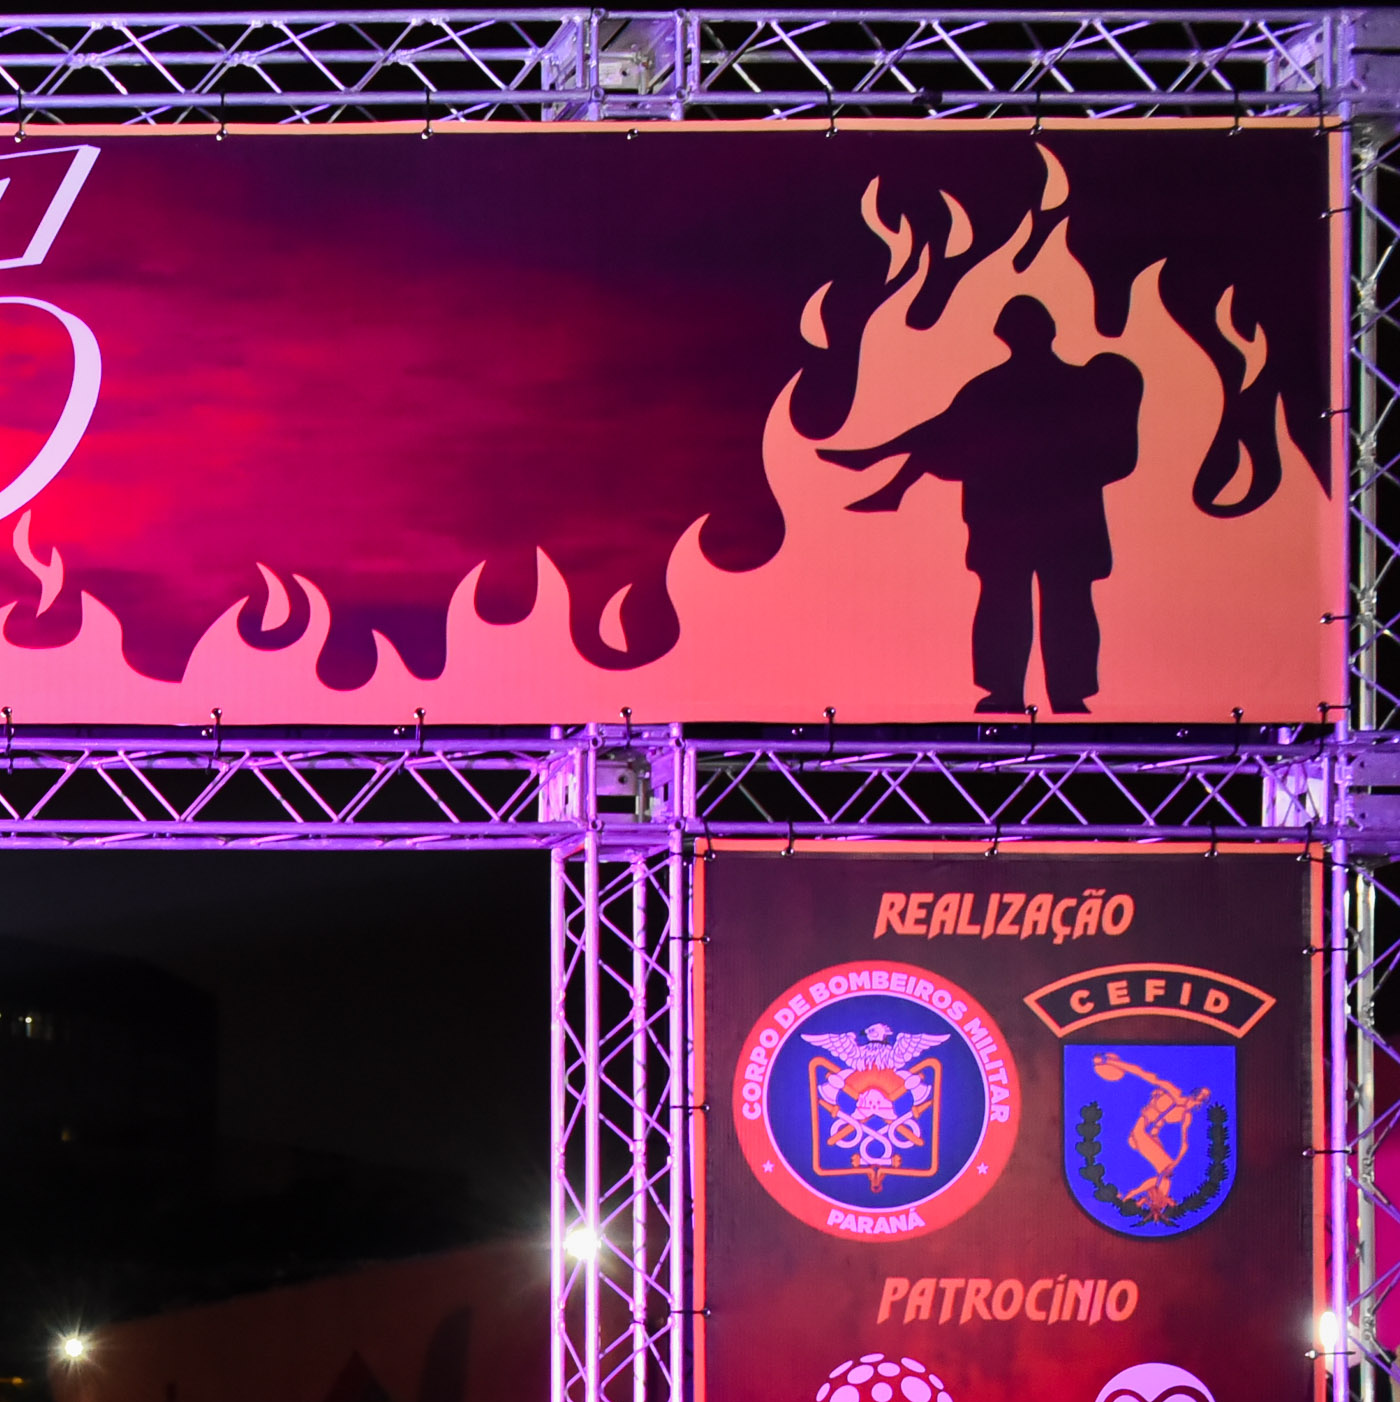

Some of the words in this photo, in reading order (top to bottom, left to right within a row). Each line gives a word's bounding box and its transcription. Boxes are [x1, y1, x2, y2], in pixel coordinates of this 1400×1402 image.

[873, 888, 1135, 945] REALIZAÇÃO
[1069, 978, 1230, 1015] CEFID
[741, 1028, 780, 1121] CORPO
[773, 993, 811, 1030] DE
[808, 970, 968, 1022] BOMBEIROS
[962, 1016, 1011, 1124] MILITAR
[826, 1207, 926, 1235] PARANÁ
[876, 1274, 1139, 1326] PATROCÍNIO
